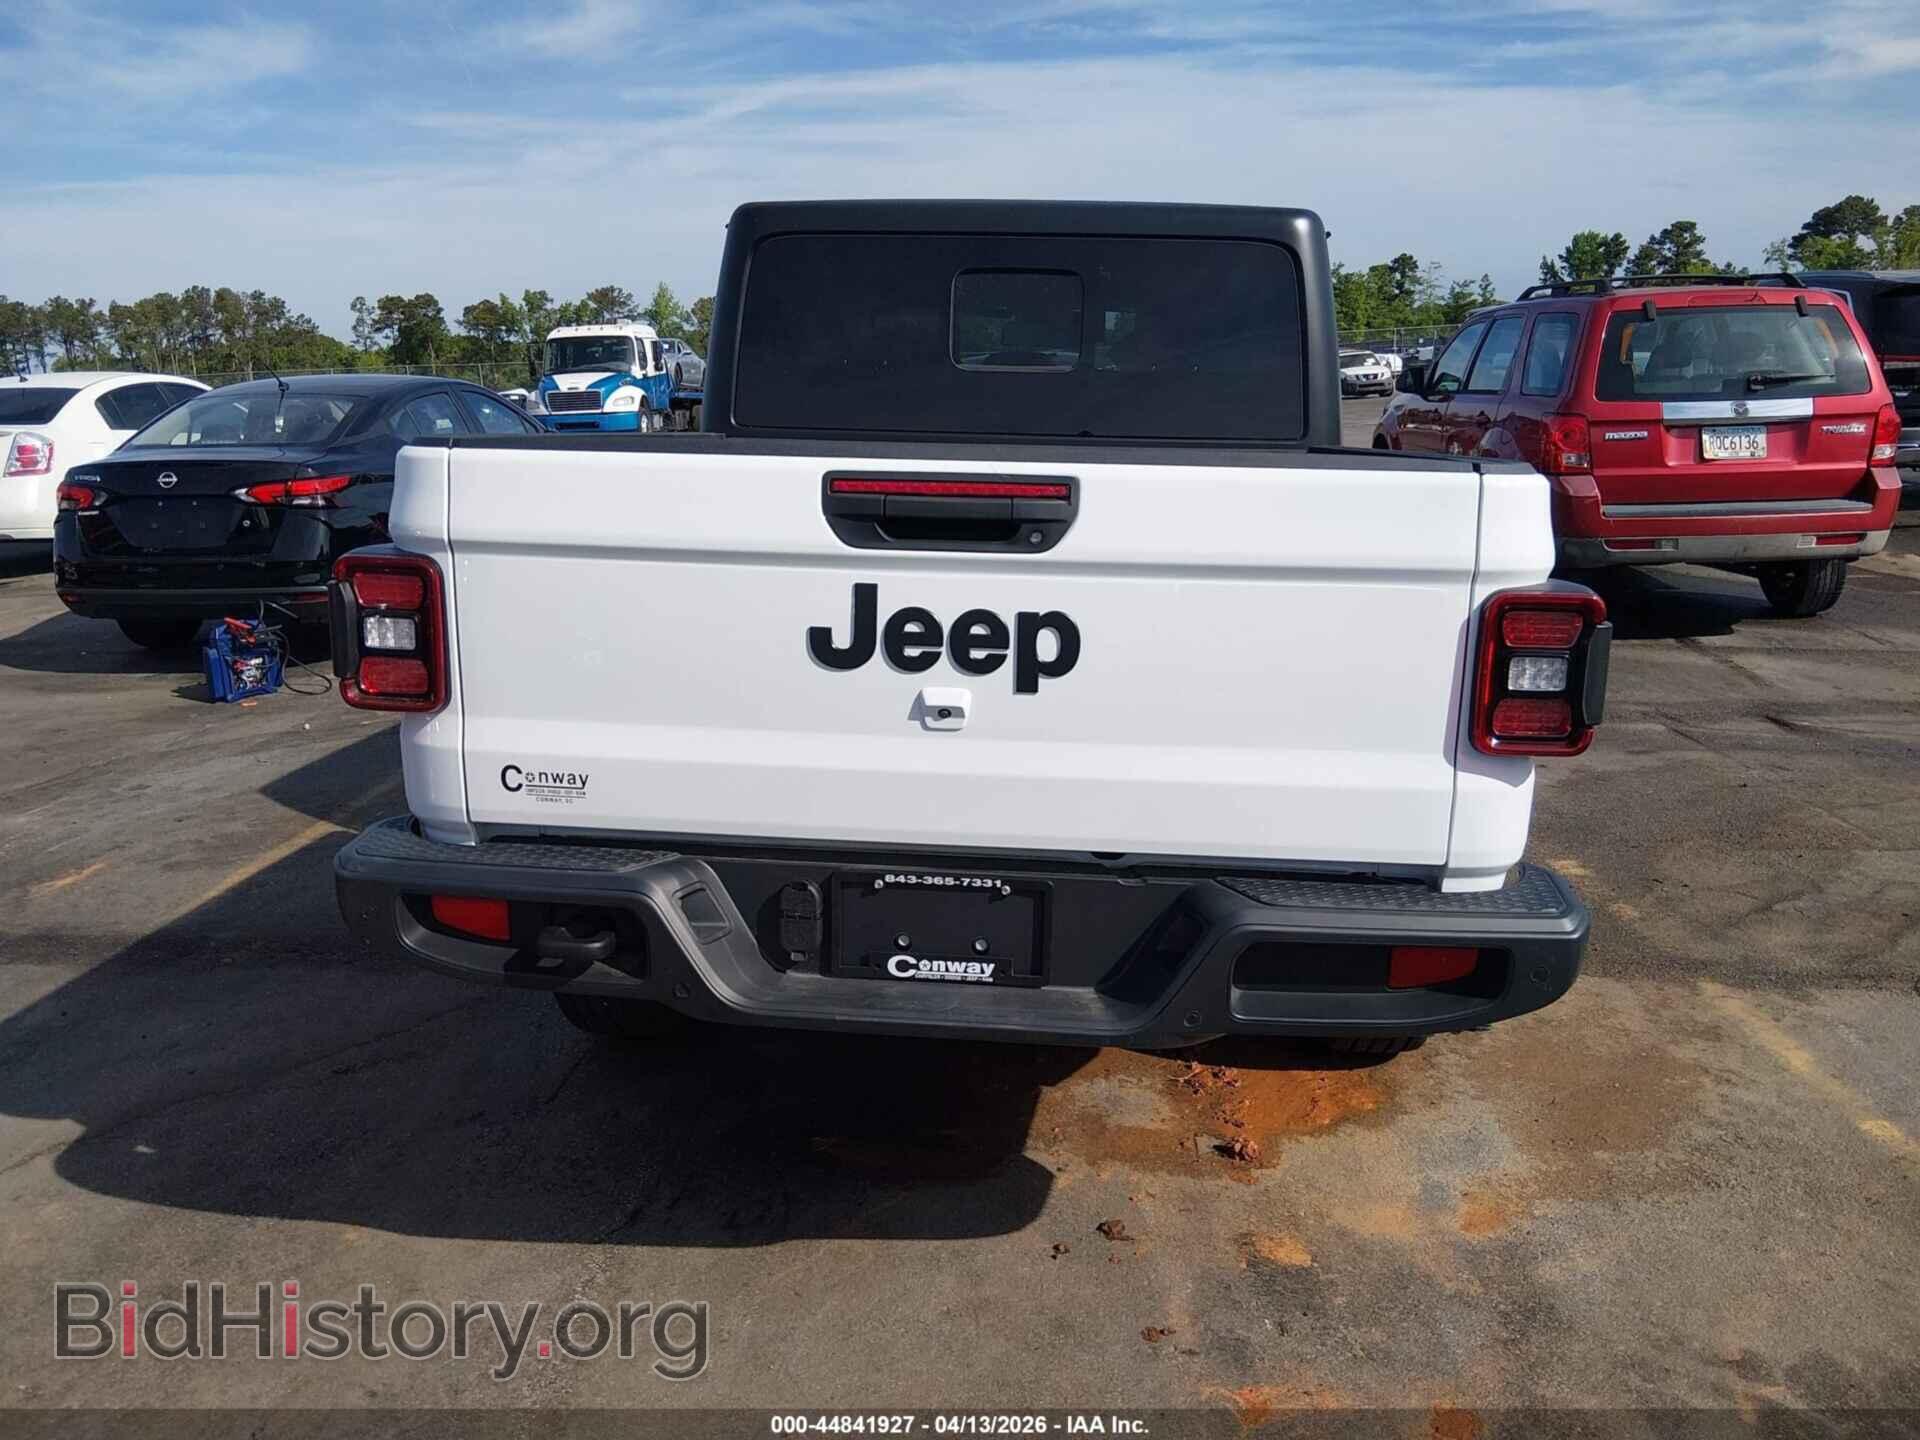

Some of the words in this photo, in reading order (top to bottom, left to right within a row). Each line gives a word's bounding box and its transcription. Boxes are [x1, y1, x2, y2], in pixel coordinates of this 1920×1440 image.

[806, 582, 1081, 695] Jeep
[501, 764, 589, 792] Conway
[884, 874, 1002, 888] 843-365-7331
[887, 954, 995, 978] Conway
